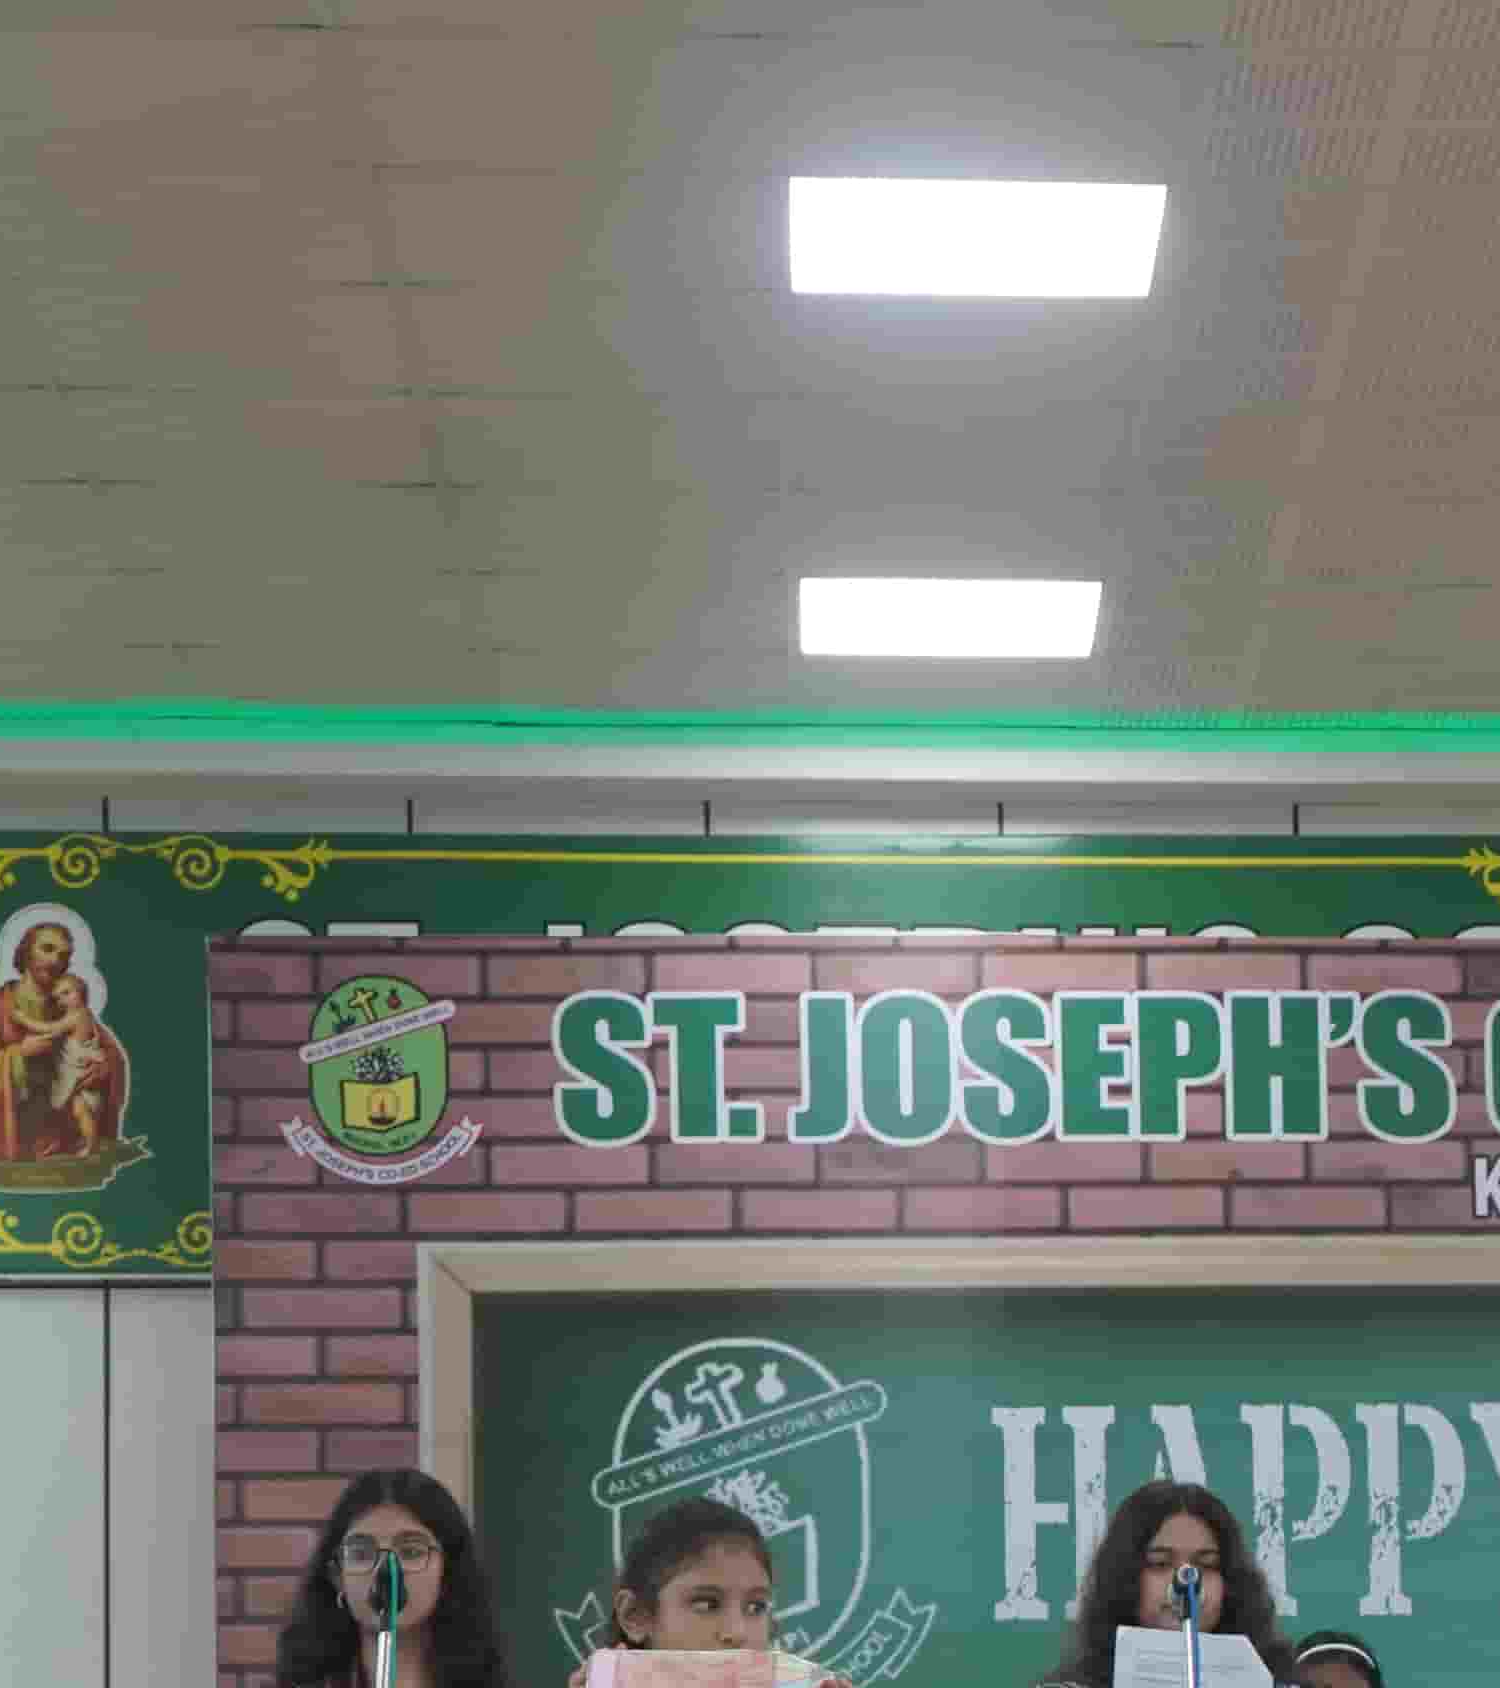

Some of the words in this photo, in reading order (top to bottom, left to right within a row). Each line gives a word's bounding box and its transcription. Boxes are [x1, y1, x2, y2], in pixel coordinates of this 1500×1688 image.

[551, 989, 764, 1147] ST.
[788, 988, 1458, 1145] JOSEPH'S
[658, 1445, 711, 1480] WELL
[711, 1428, 768, 1462] WHEN
[767, 1410, 822, 1443] DONE
[824, 1393, 876, 1424] WELL
